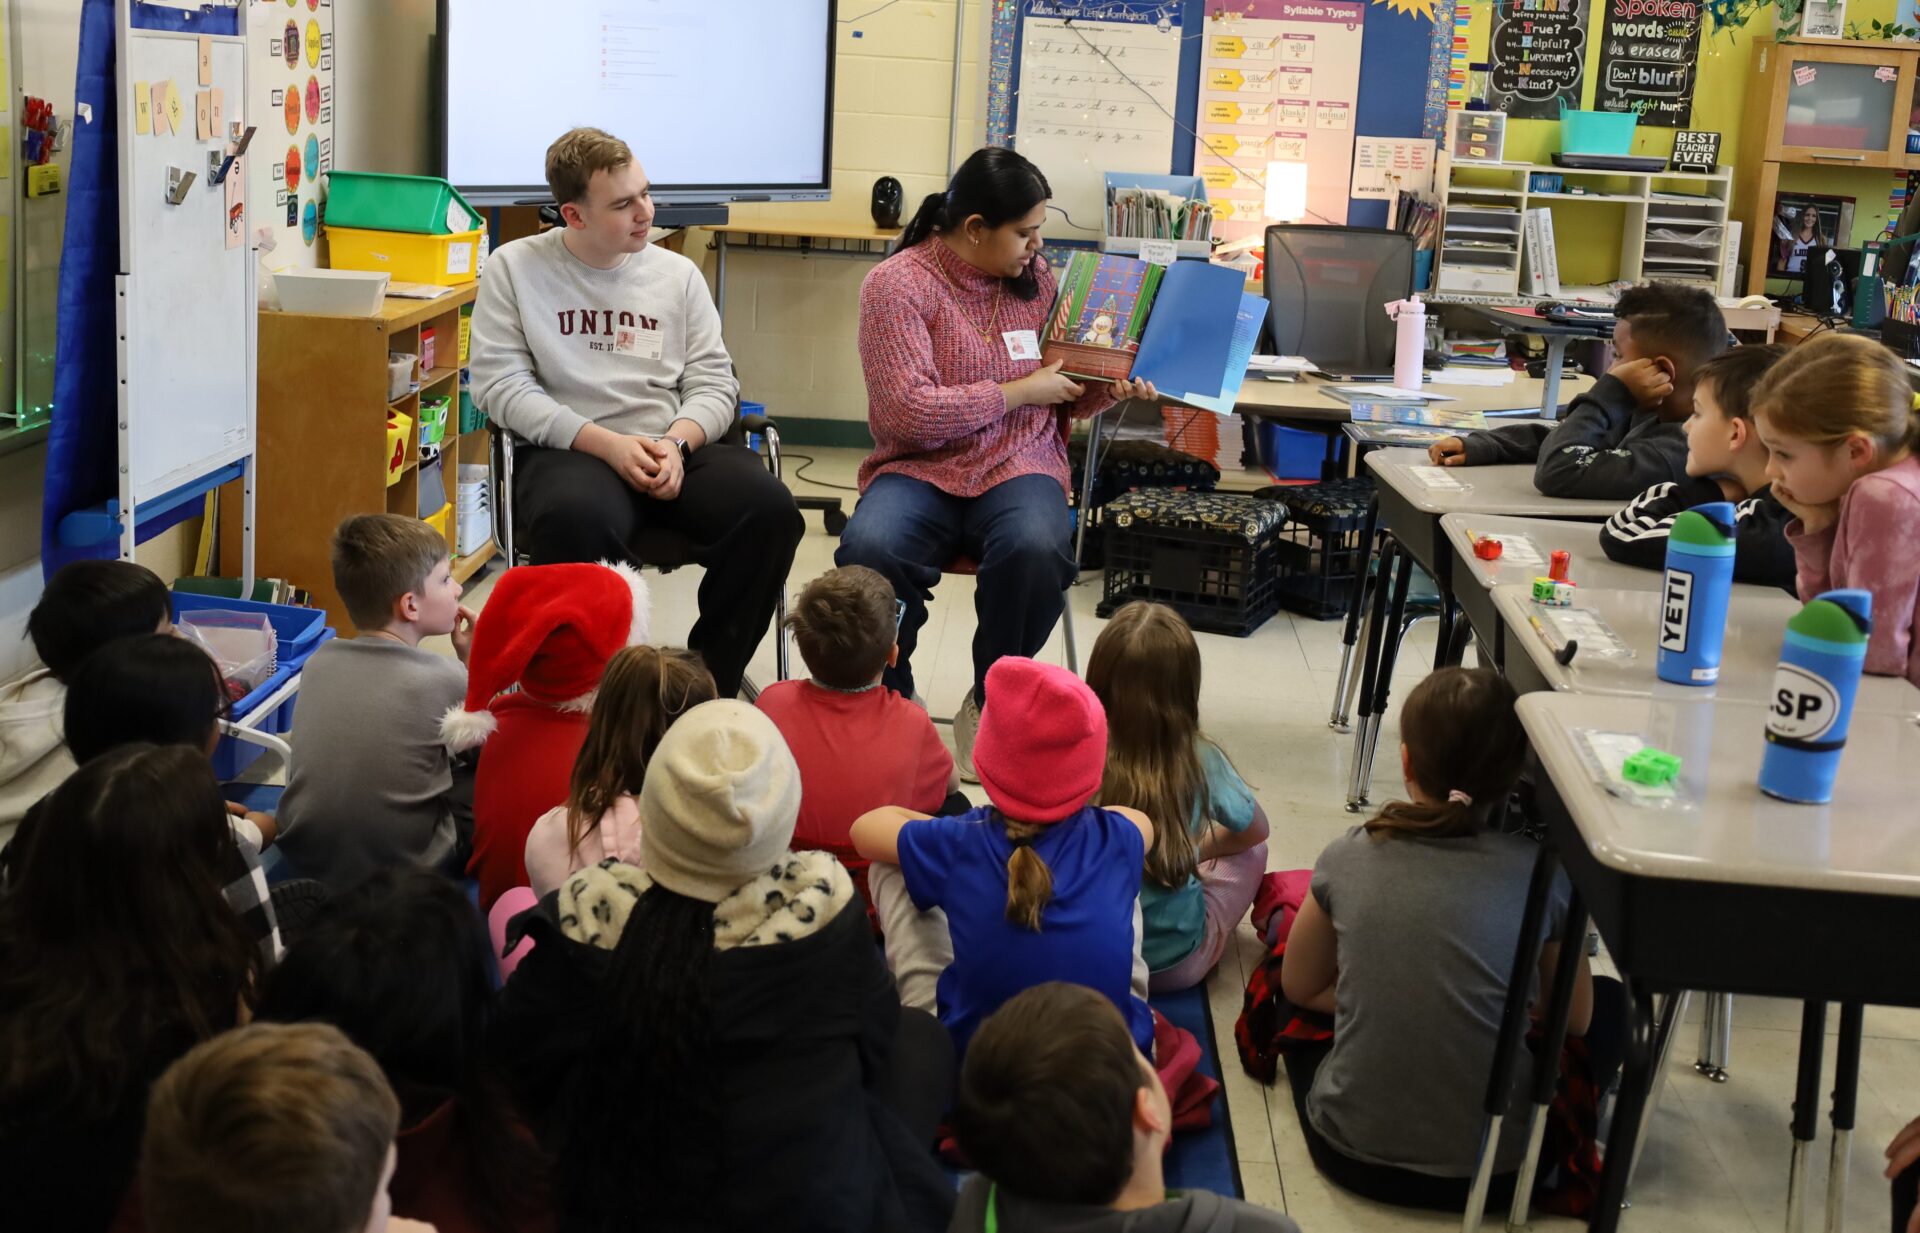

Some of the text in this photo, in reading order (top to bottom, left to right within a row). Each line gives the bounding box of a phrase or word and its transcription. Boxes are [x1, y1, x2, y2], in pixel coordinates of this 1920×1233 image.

[1283, 5, 1357, 18] Syllable Types
[1513, 0, 1570, 12] THINK
[1613, 0, 1696, 19] Spoken
[1523, 21, 1561, 34] True?
[1611, 21, 1664, 39] words
[1521, 35, 1570, 50] Helpful?
[1609, 40, 1682, 60] be erased
[1519, 63, 1577, 80] Necessary?
[1612, 67, 1683, 86] Don't blurt
[1518, 77, 1553, 89] Kind?
[1280, 107, 1306, 118] Alaska
[1317, 111, 1347, 120] animal
[1676, 132, 1718, 144] BEST
[1675, 143, 1716, 153] TEACHER
[1673, 153, 1713, 164] EVER
[1726, 240, 1737, 275] DIBELS
[558, 309, 658, 336] UNION
[589, 341, 614, 352] EST. 17
[1663, 577, 1686, 643] YETI
[1770, 688, 1823, 721] SP
